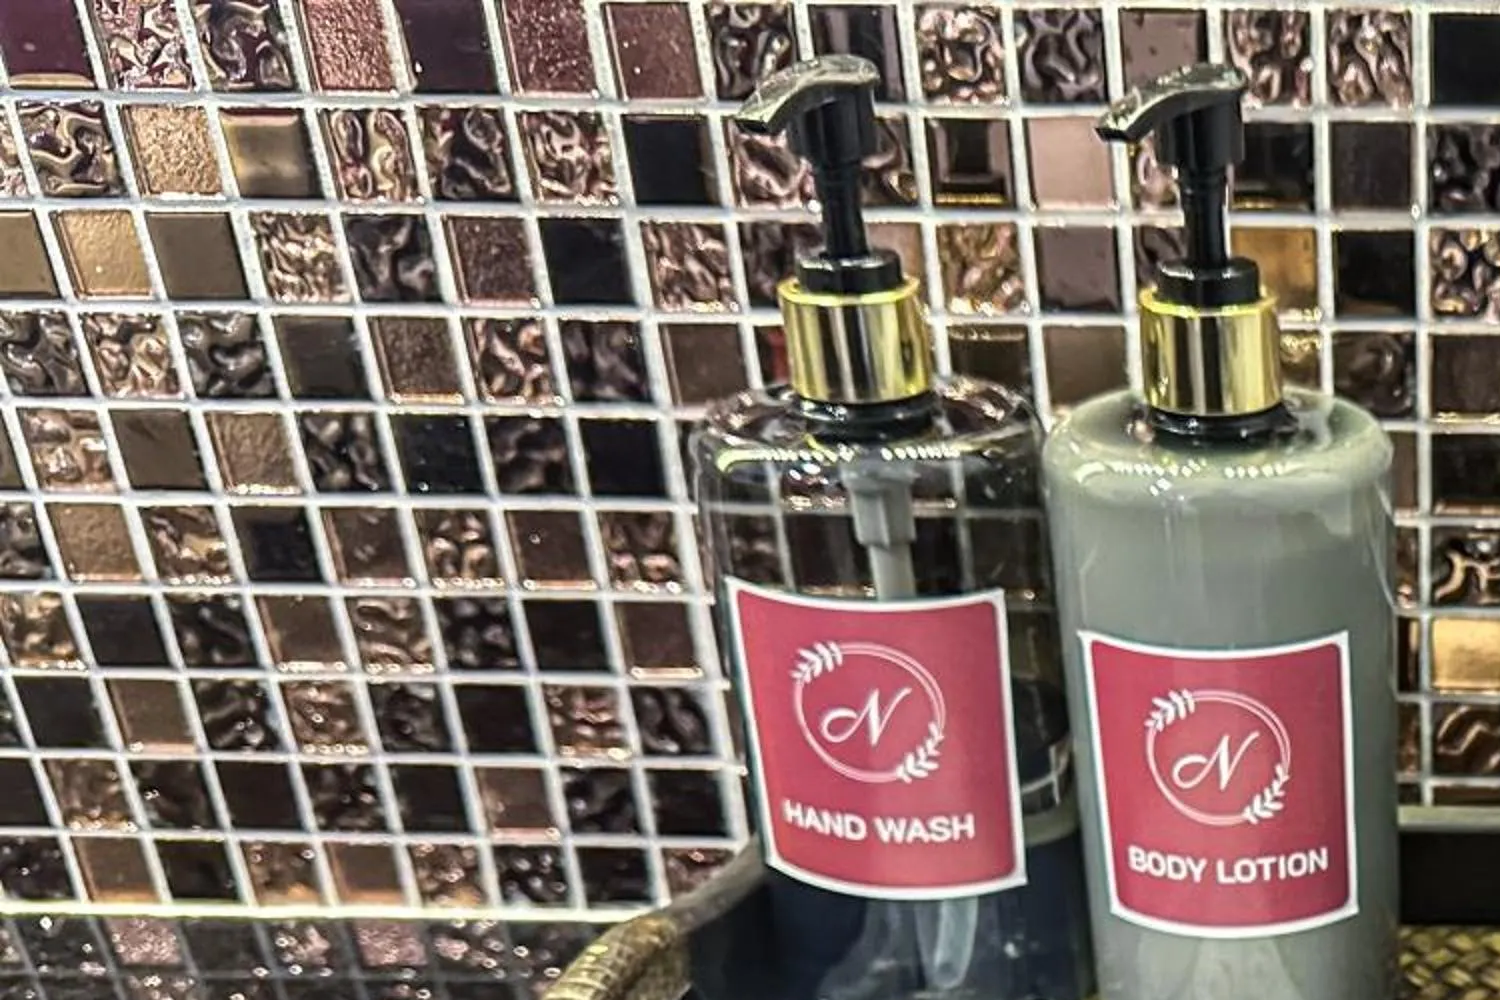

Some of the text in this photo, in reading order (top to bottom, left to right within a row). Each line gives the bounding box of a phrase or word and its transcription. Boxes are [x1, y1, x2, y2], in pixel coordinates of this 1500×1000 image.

[782, 797, 975, 843] HAND WASH
[1127, 845, 1329, 884] BODY LOTION
